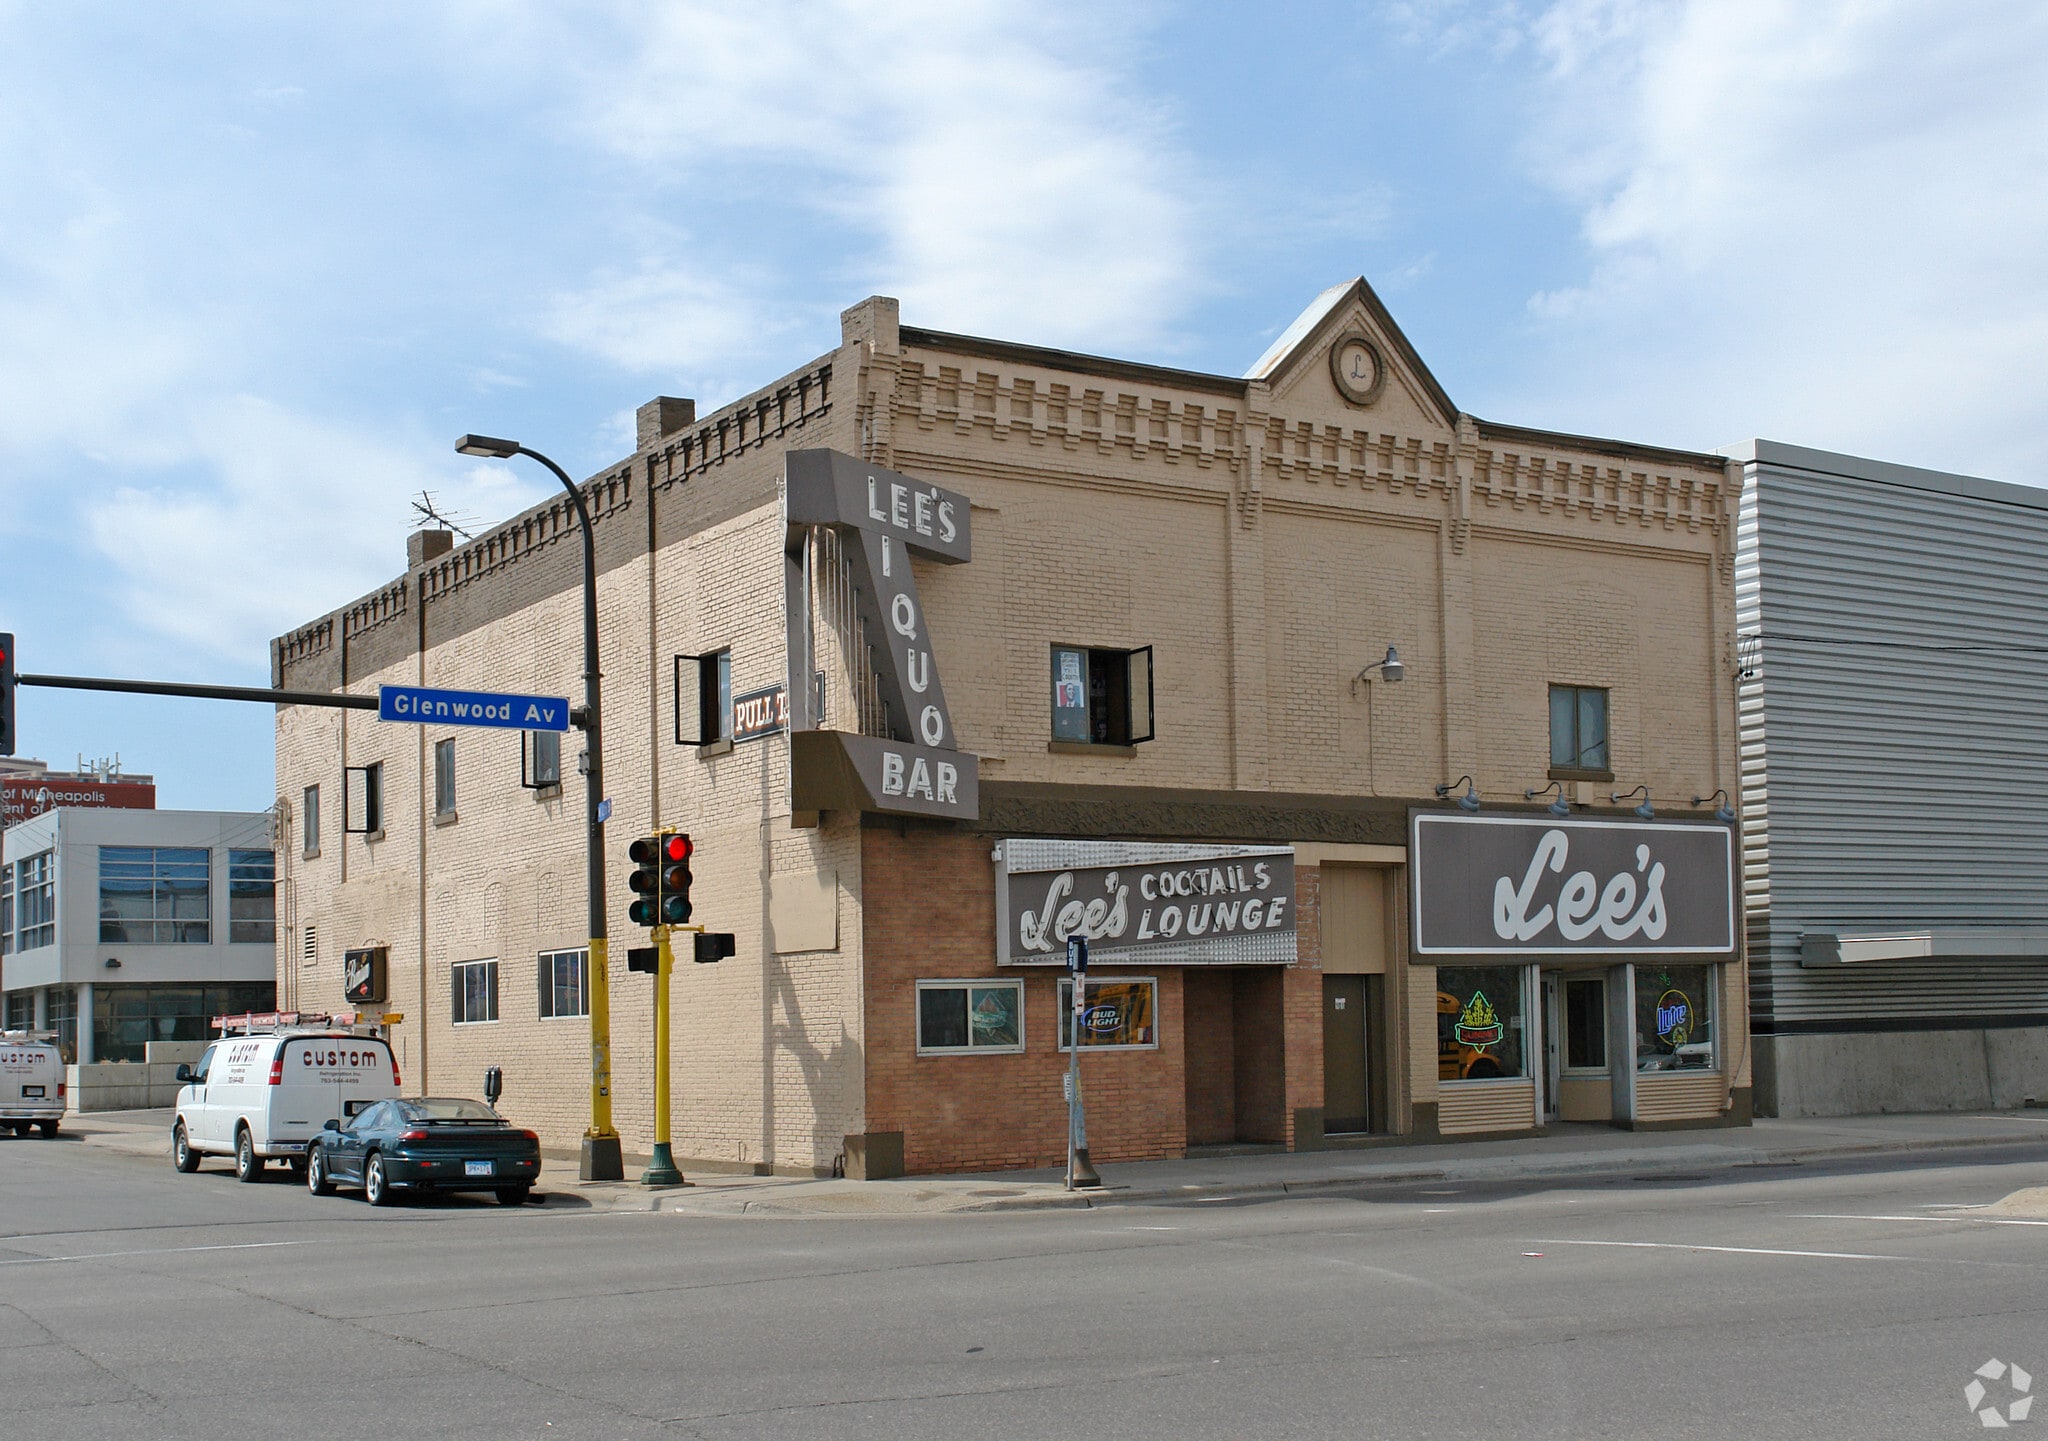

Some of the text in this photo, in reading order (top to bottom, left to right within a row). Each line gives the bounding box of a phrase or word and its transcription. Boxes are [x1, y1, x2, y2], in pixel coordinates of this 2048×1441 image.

[1351, 354, 1366, 379] L
[868, 475, 957, 544] LEE'S
[394, 694, 556, 724] Glenwood Av
[735, 695, 774, 733] PULL
[21, 788, 106, 804] Mineapolis
[882, 751, 958, 805] BAR
[1140, 861, 1272, 902] COCKTAILS
[1494, 829, 1667, 941] Lee's
[1020, 871, 1129, 952] Lee's
[1136, 896, 1288, 940] LOUNGE
[1086, 1017, 1120, 1028] LIGHT
[1091, 1010, 1116, 1020] BUD
